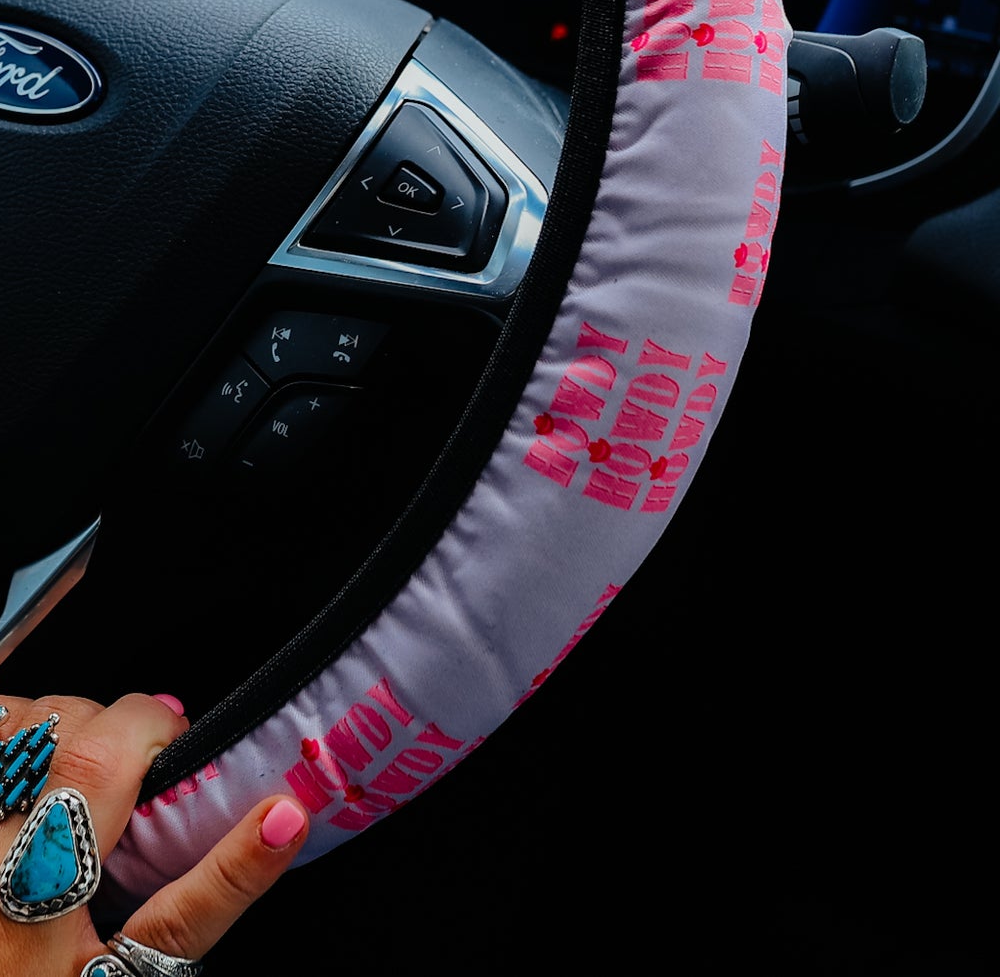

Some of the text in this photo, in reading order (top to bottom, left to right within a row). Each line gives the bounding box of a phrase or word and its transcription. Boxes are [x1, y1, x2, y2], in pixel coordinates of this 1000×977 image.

[397, 181, 419, 199] OK
[728, 139, 782, 306] HOWDY
[271, 419, 290, 439] VOL
[522, 321, 629, 488] HOWDY
[581, 338, 692, 511] HOWDY
[639, 352, 728, 513] HOWDY
[283, 677, 415, 814] HOWDY
[328, 722, 466, 831] HOWDY
